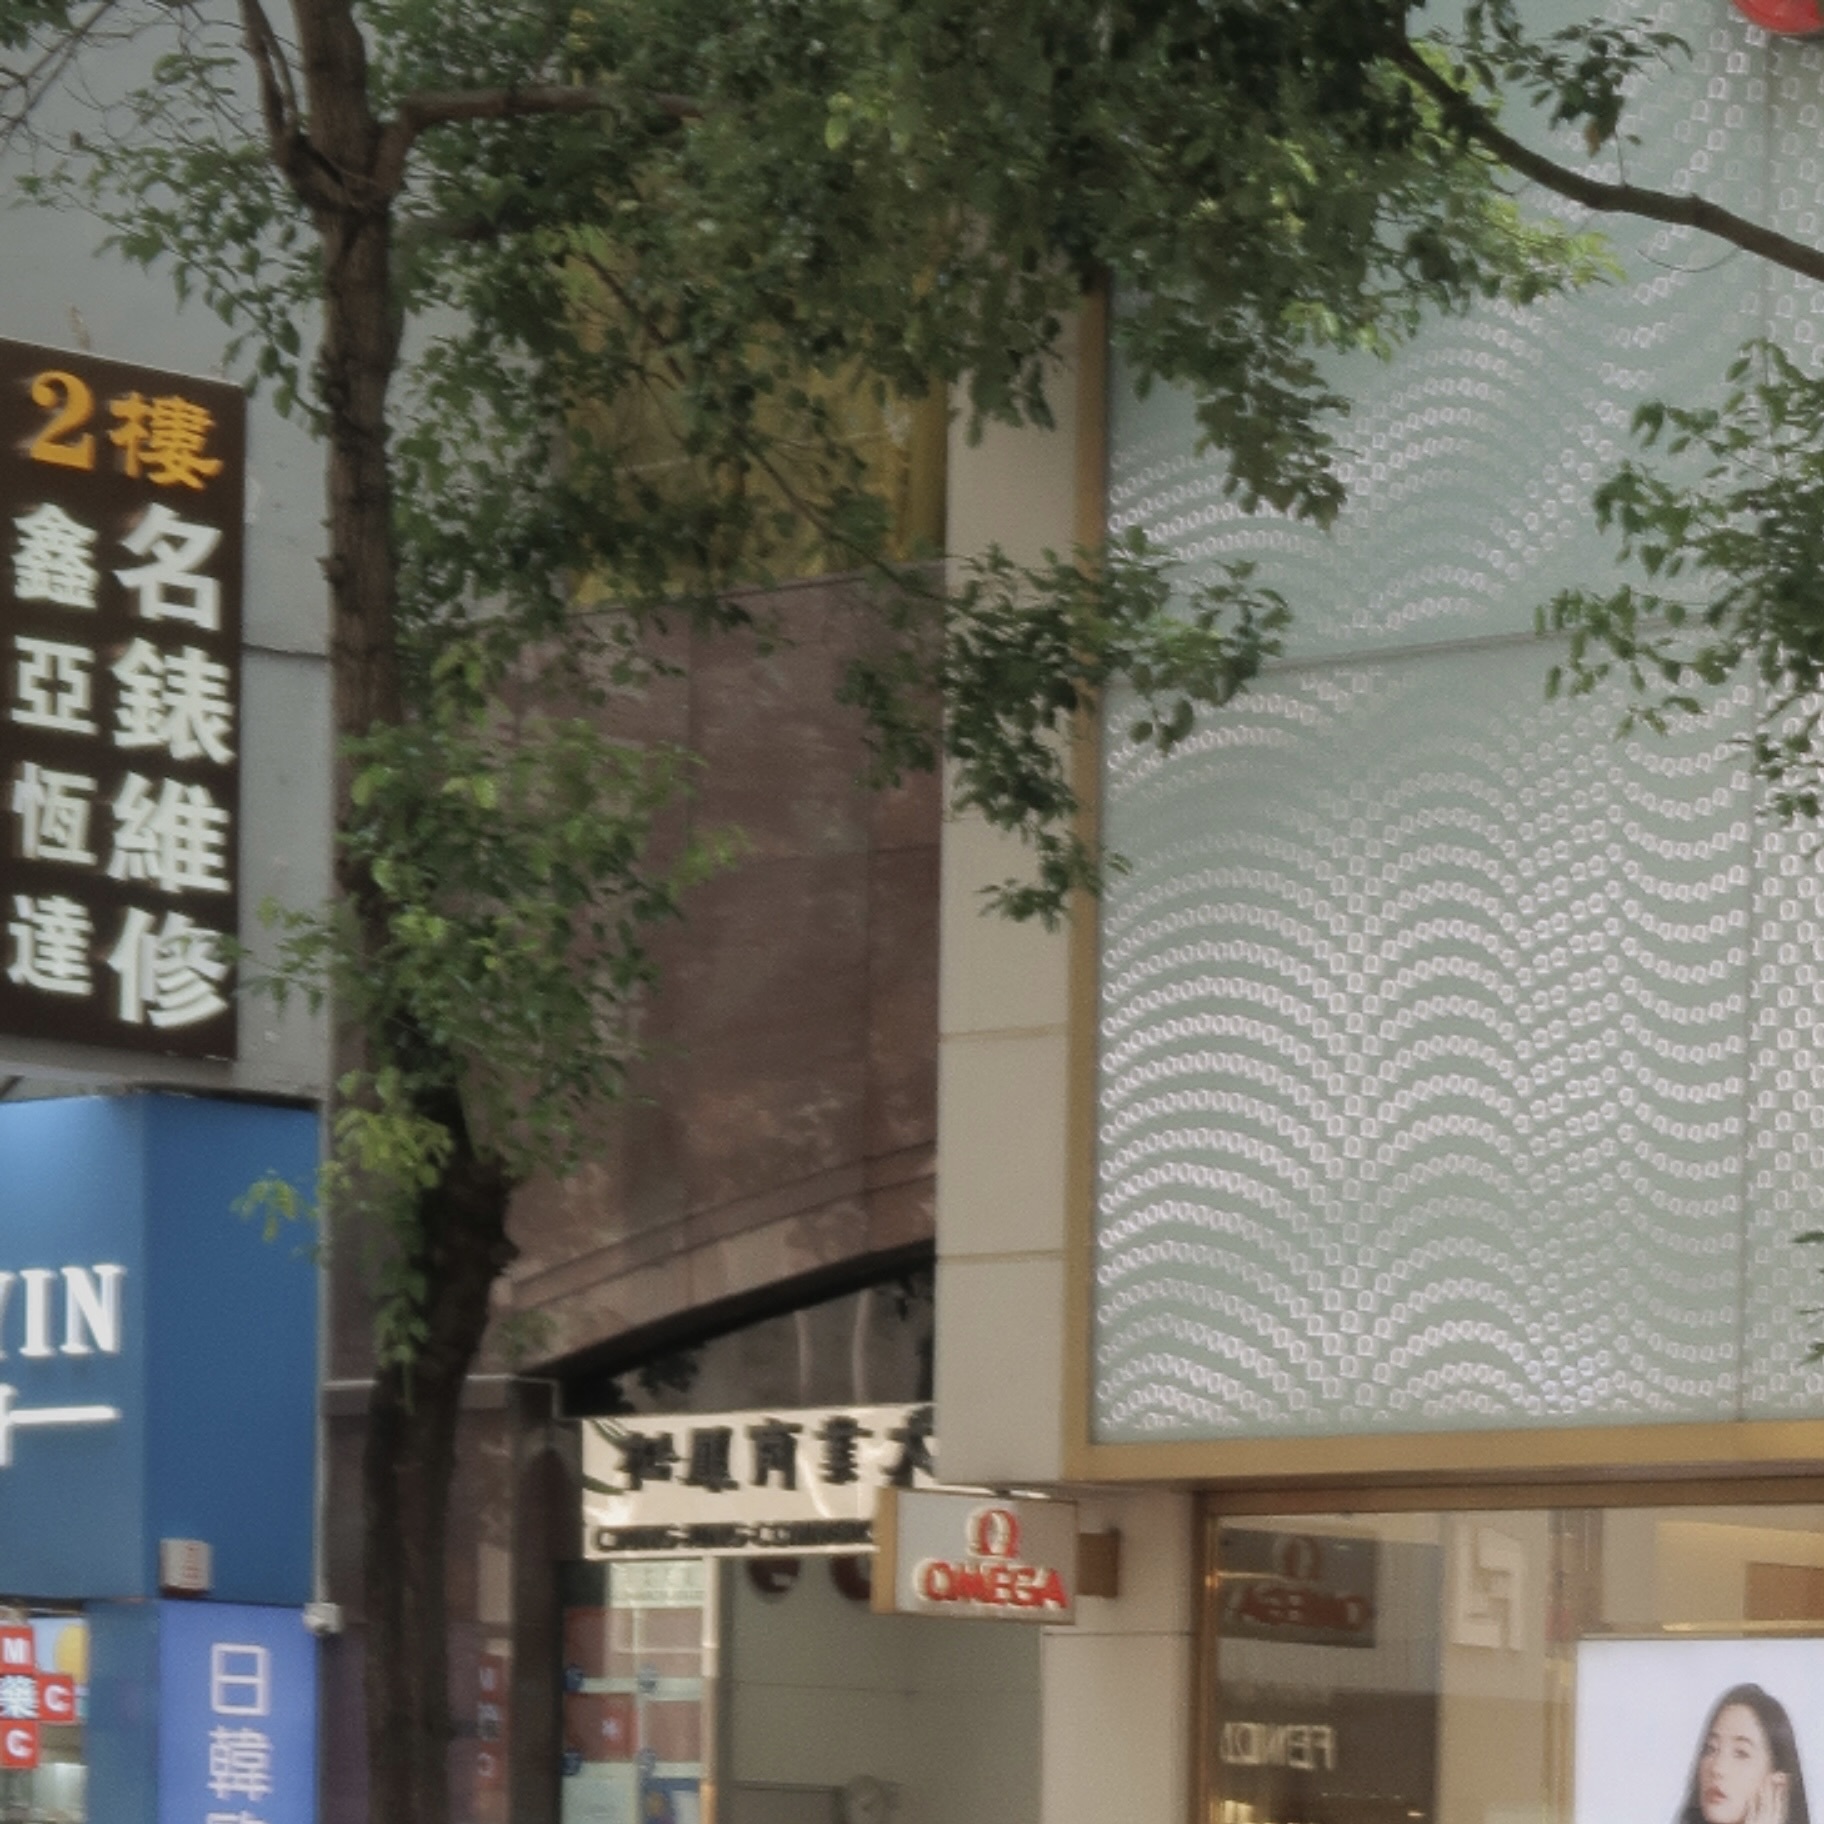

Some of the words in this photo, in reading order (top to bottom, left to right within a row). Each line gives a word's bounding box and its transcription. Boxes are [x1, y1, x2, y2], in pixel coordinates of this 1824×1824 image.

[106, 502, 234, 1029] 名錶維修
[913, 1558, 1069, 1609] OMEGA
